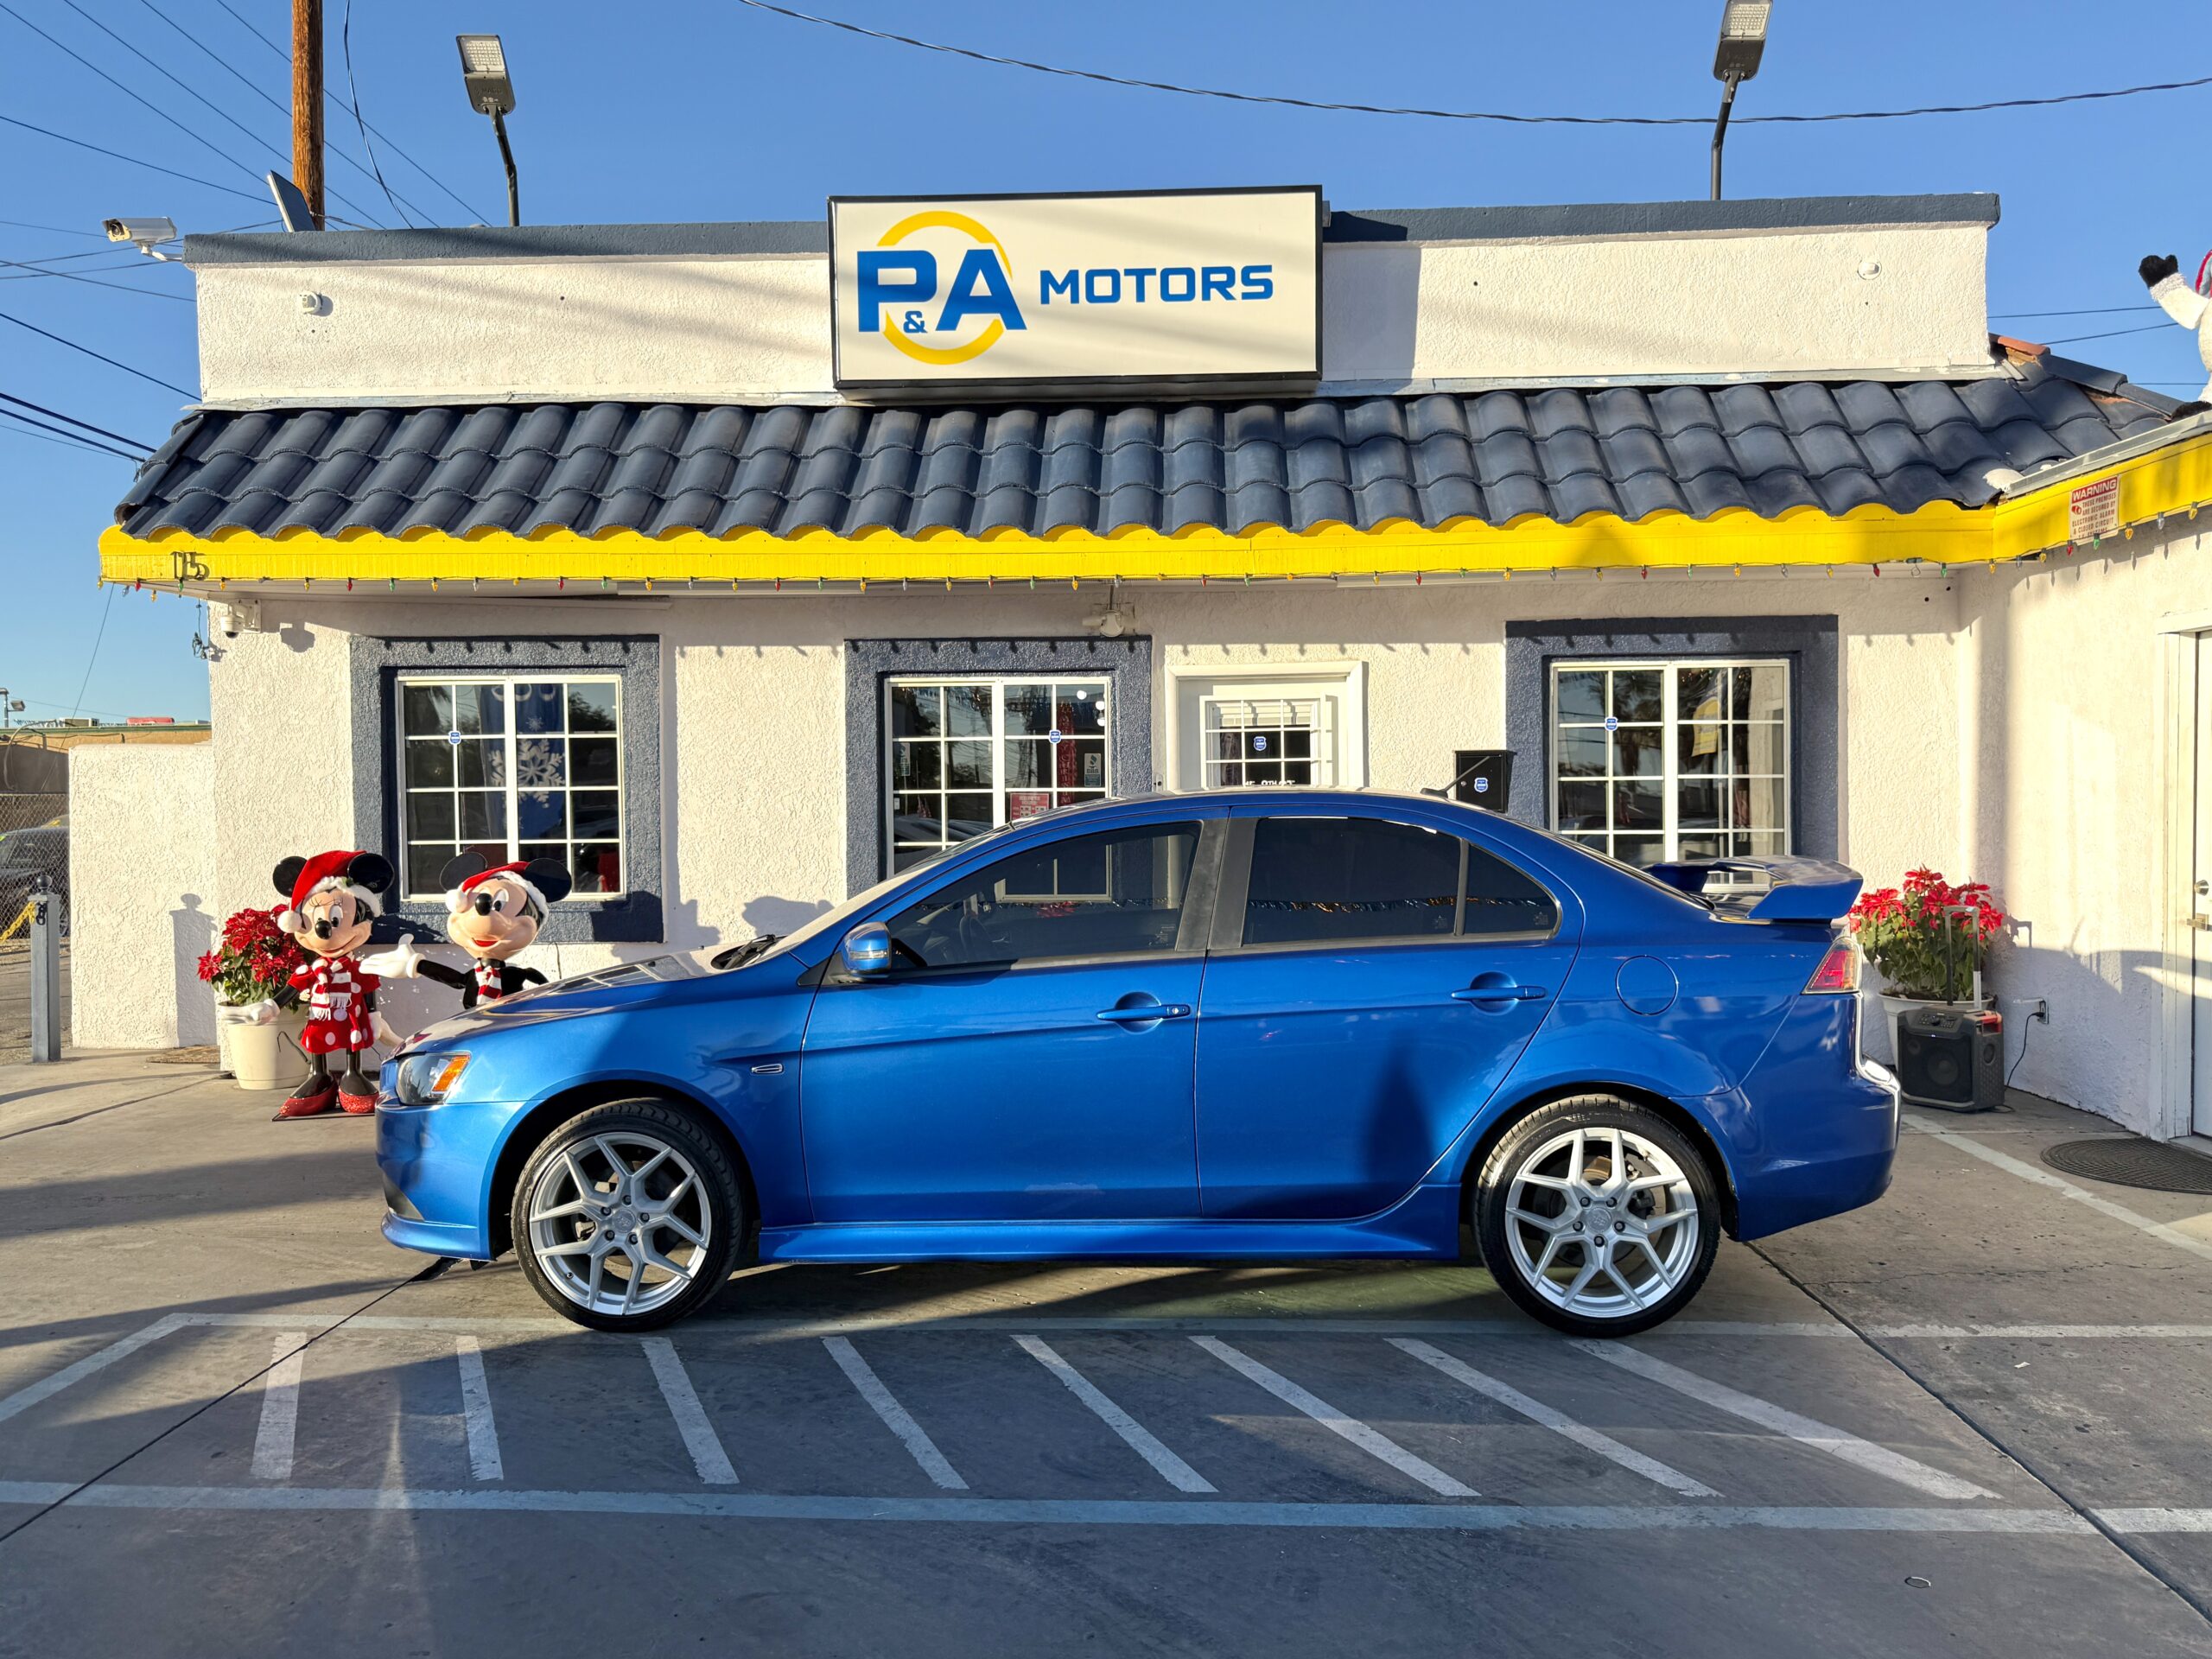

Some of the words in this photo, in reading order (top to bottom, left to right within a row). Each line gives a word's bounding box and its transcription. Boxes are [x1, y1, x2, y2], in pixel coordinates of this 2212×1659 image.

[1039, 264, 1274, 305] MOTORS
[2073, 480, 2116, 501] WARNING
[2082, 499, 2094, 508] THESE
[2096, 493, 2116, 503] PREMISES
[2091, 503, 2109, 512] SECURED
[2100, 509, 2114, 518] ALARM
[2094, 518, 2113, 528] CIRCUIT
